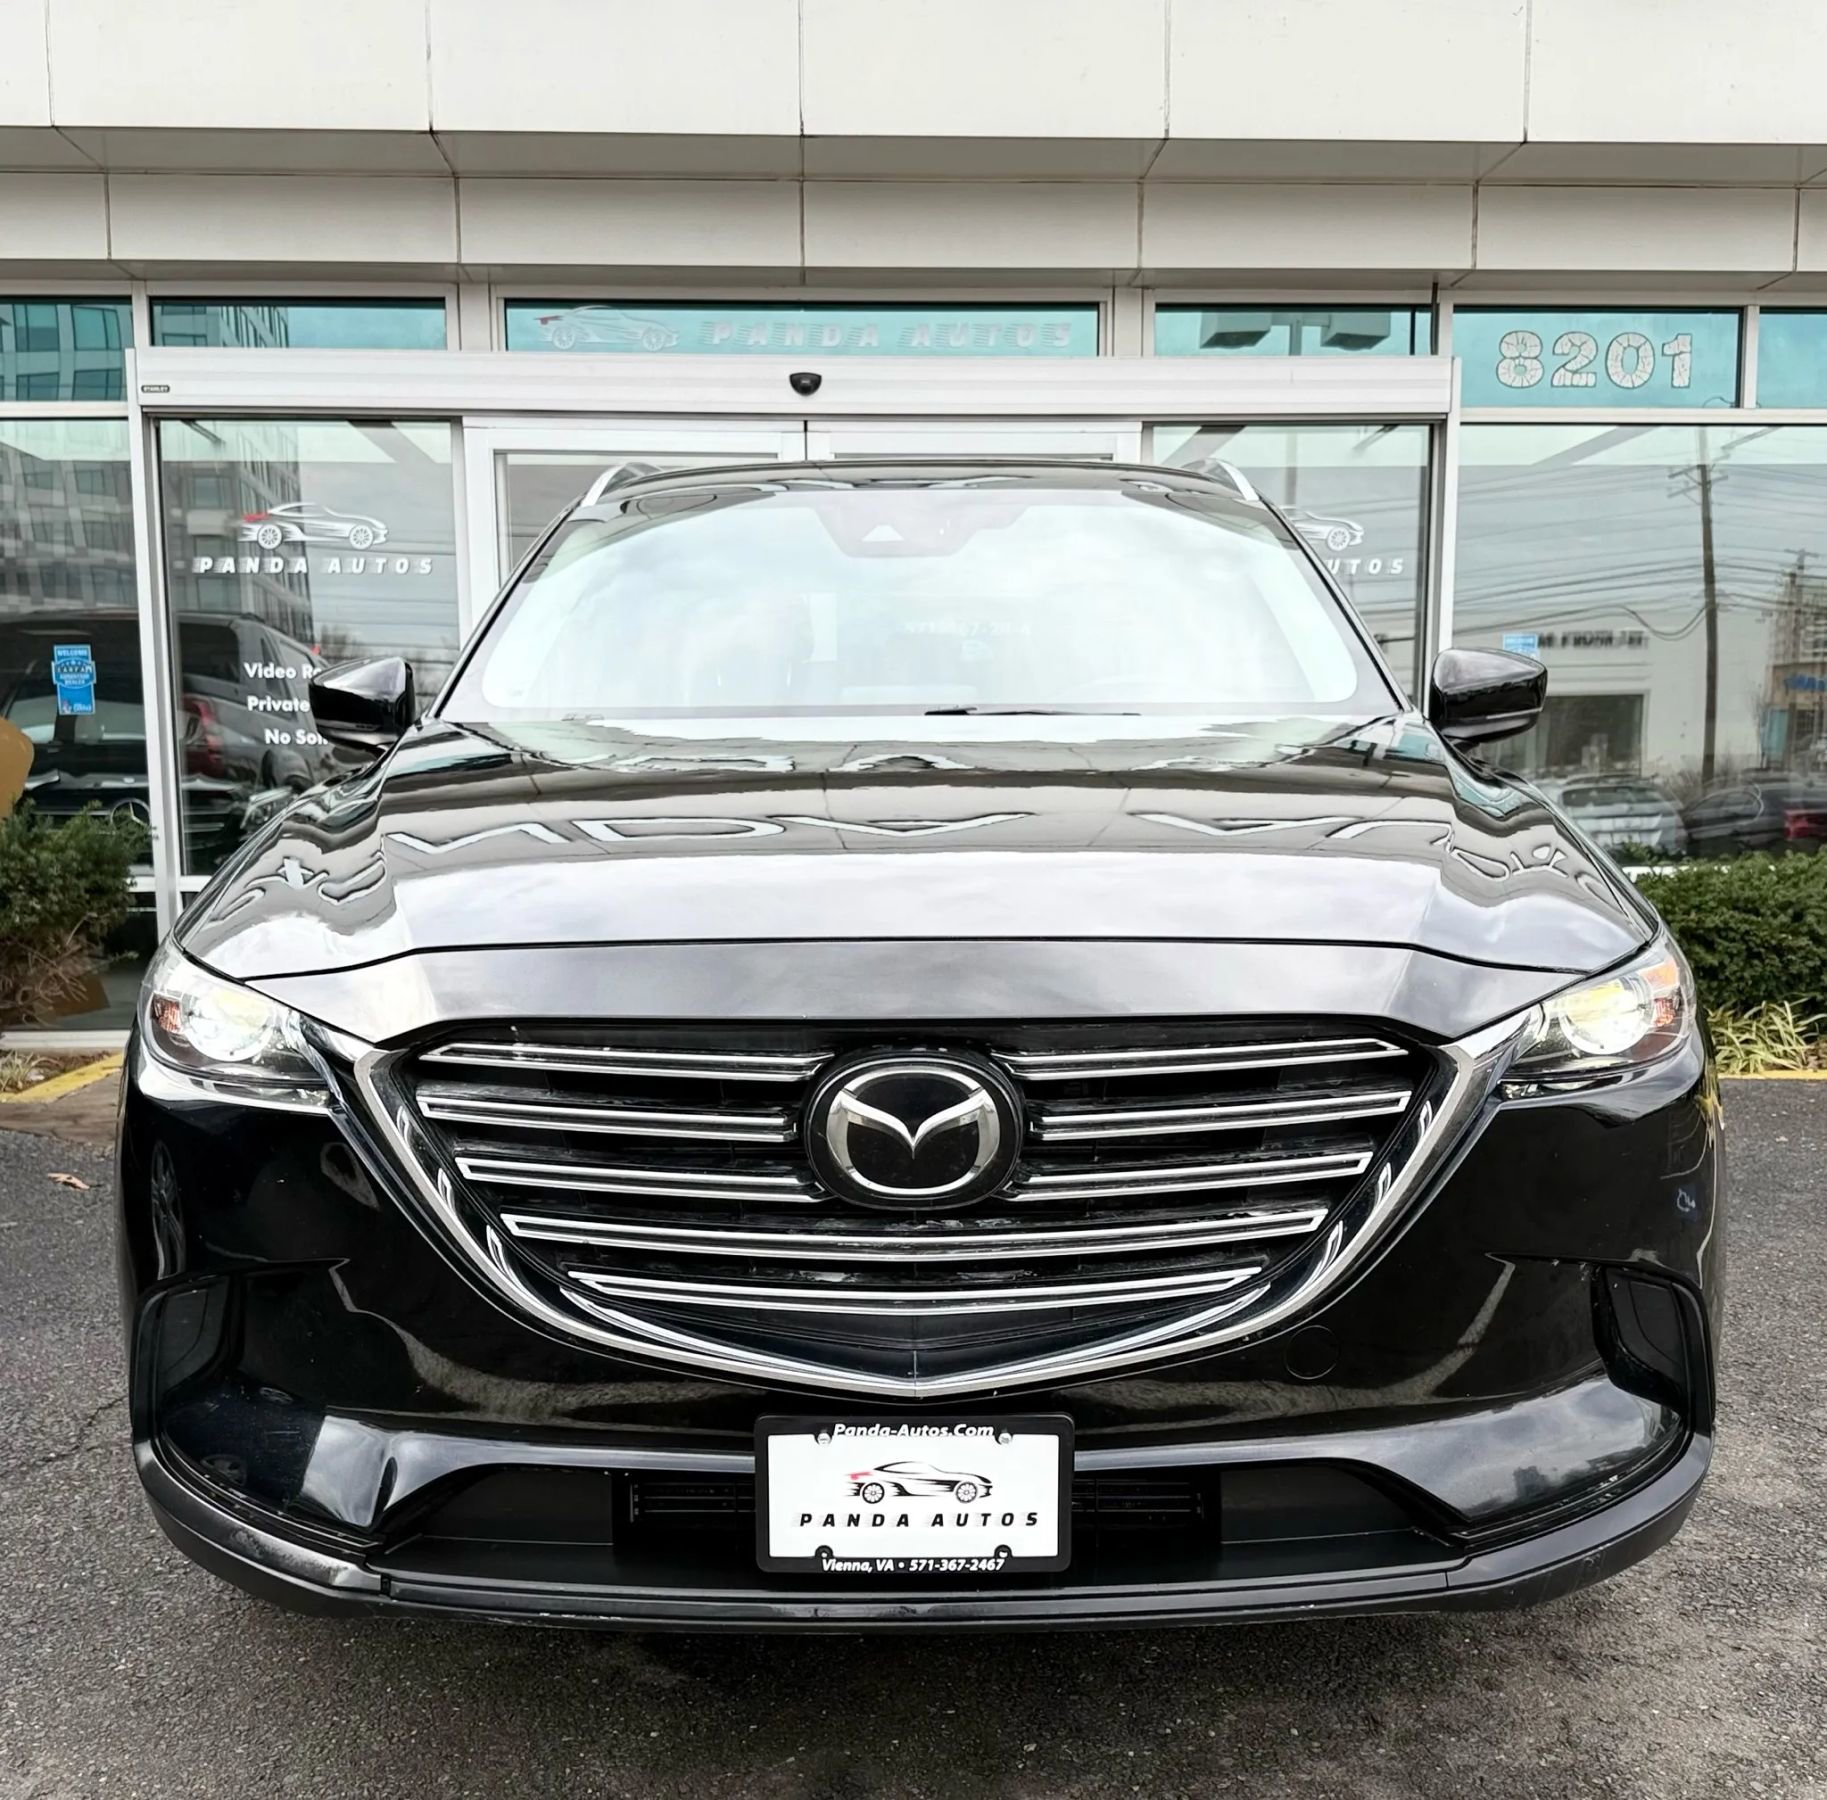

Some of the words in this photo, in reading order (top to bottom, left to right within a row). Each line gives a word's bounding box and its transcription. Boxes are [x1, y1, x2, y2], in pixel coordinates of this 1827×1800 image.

[711, 322, 879, 348] PANDA
[910, 322, 1072, 348] AUTOS
[1496, 330, 1693, 390] 8201
[198, 557, 308, 574] PANDA
[327, 557, 433, 575] AUTOS
[244, 662, 297, 679] Video
[247, 695, 310, 713] Private
[264, 728, 291, 745] No
[799, 1513, 909, 1527] PANDA
[931, 1512, 1038, 1527] AUTOS
[822, 1558, 872, 1573] Vienna,
[876, 1559, 894, 1572] VA
[909, 1558, 1005, 1572] 571-367-2467
